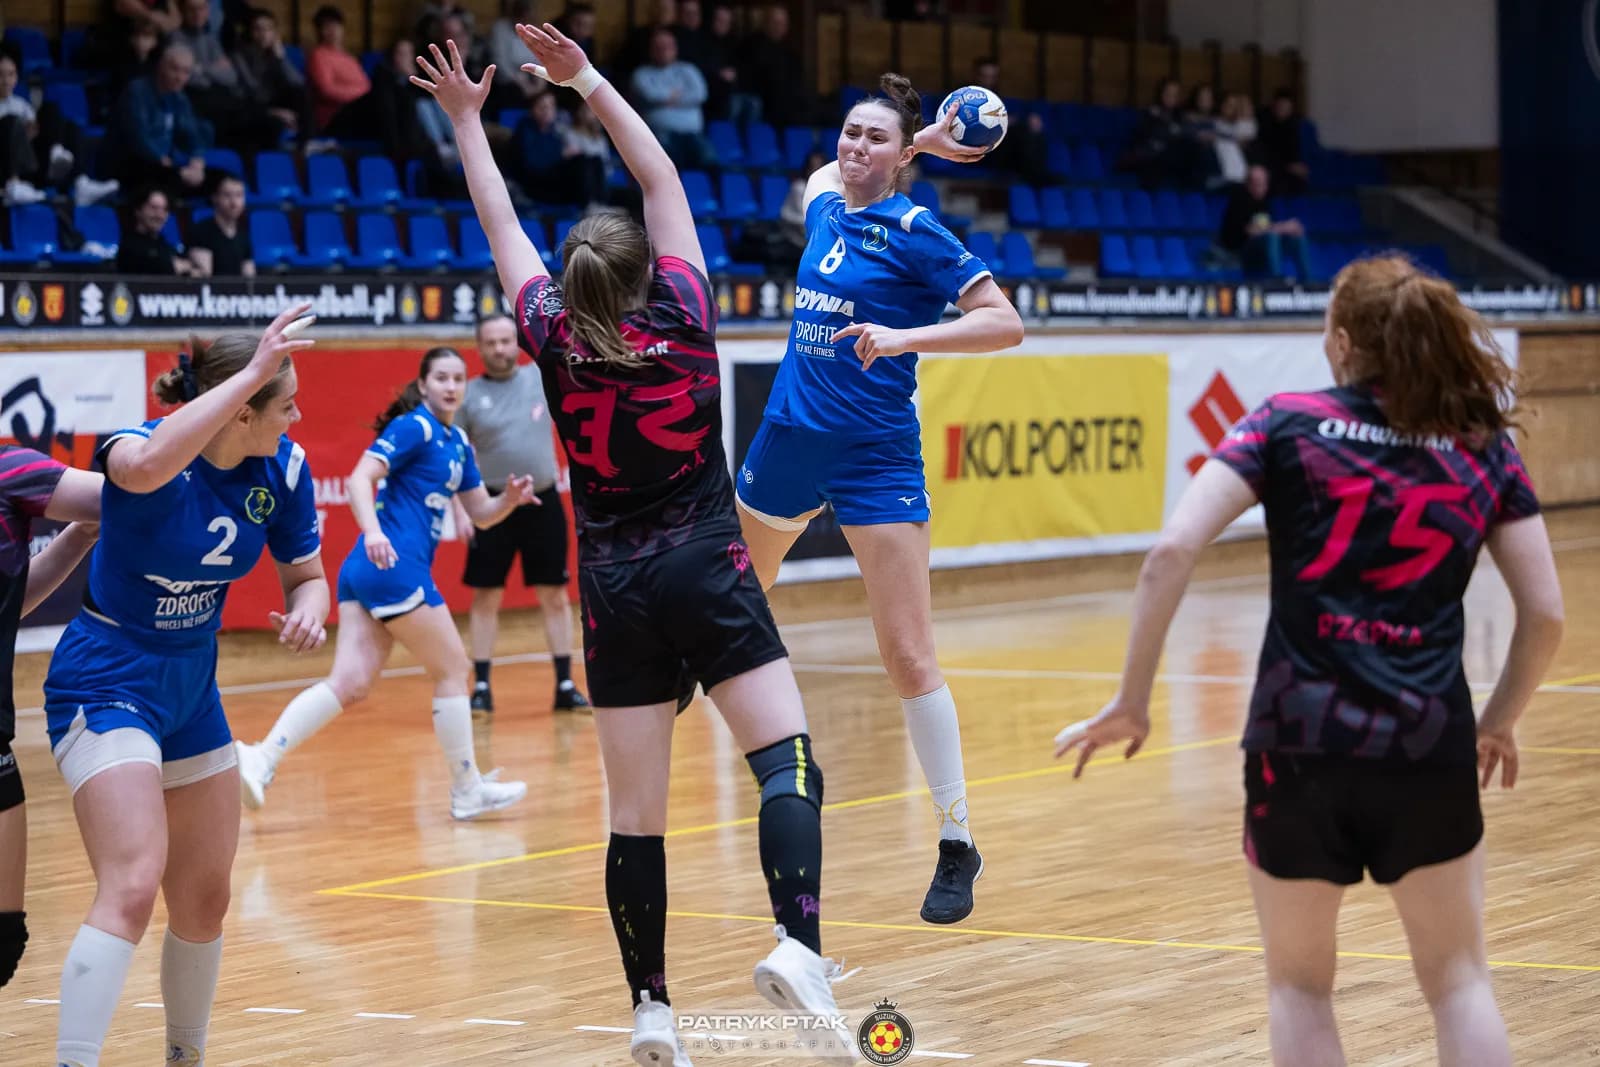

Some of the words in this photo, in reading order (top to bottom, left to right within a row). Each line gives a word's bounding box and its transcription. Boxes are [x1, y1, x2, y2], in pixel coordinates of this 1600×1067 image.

[819, 236, 847, 275] 8
[796, 320, 838, 345] DROFIT
[561, 370, 711, 479] 32
[960, 417, 1145, 479] KOLPORTER
[200, 515, 238, 566] 2
[1297, 476, 1474, 590] 15
